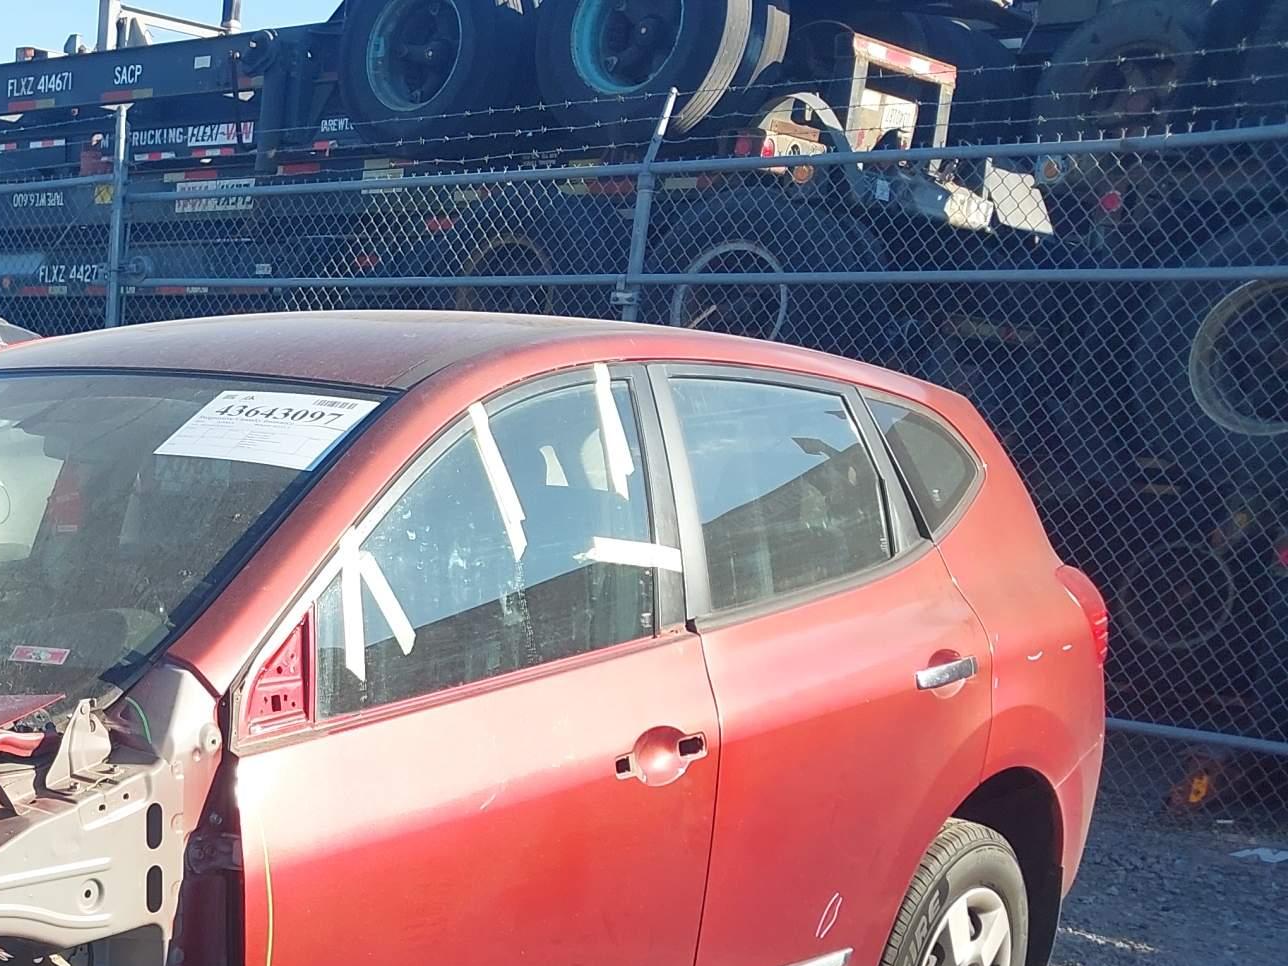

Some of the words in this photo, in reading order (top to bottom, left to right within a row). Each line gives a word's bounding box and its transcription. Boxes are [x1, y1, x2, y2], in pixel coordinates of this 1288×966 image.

[6, 76, 34, 98] FLXZ
[37, 71, 73, 93] 414671
[113, 64, 143, 85] SACP
[38, 264, 66, 283] FLXZ
[68, 263, 108, 282] 4427
[214, 403, 345, 425] 43643097
